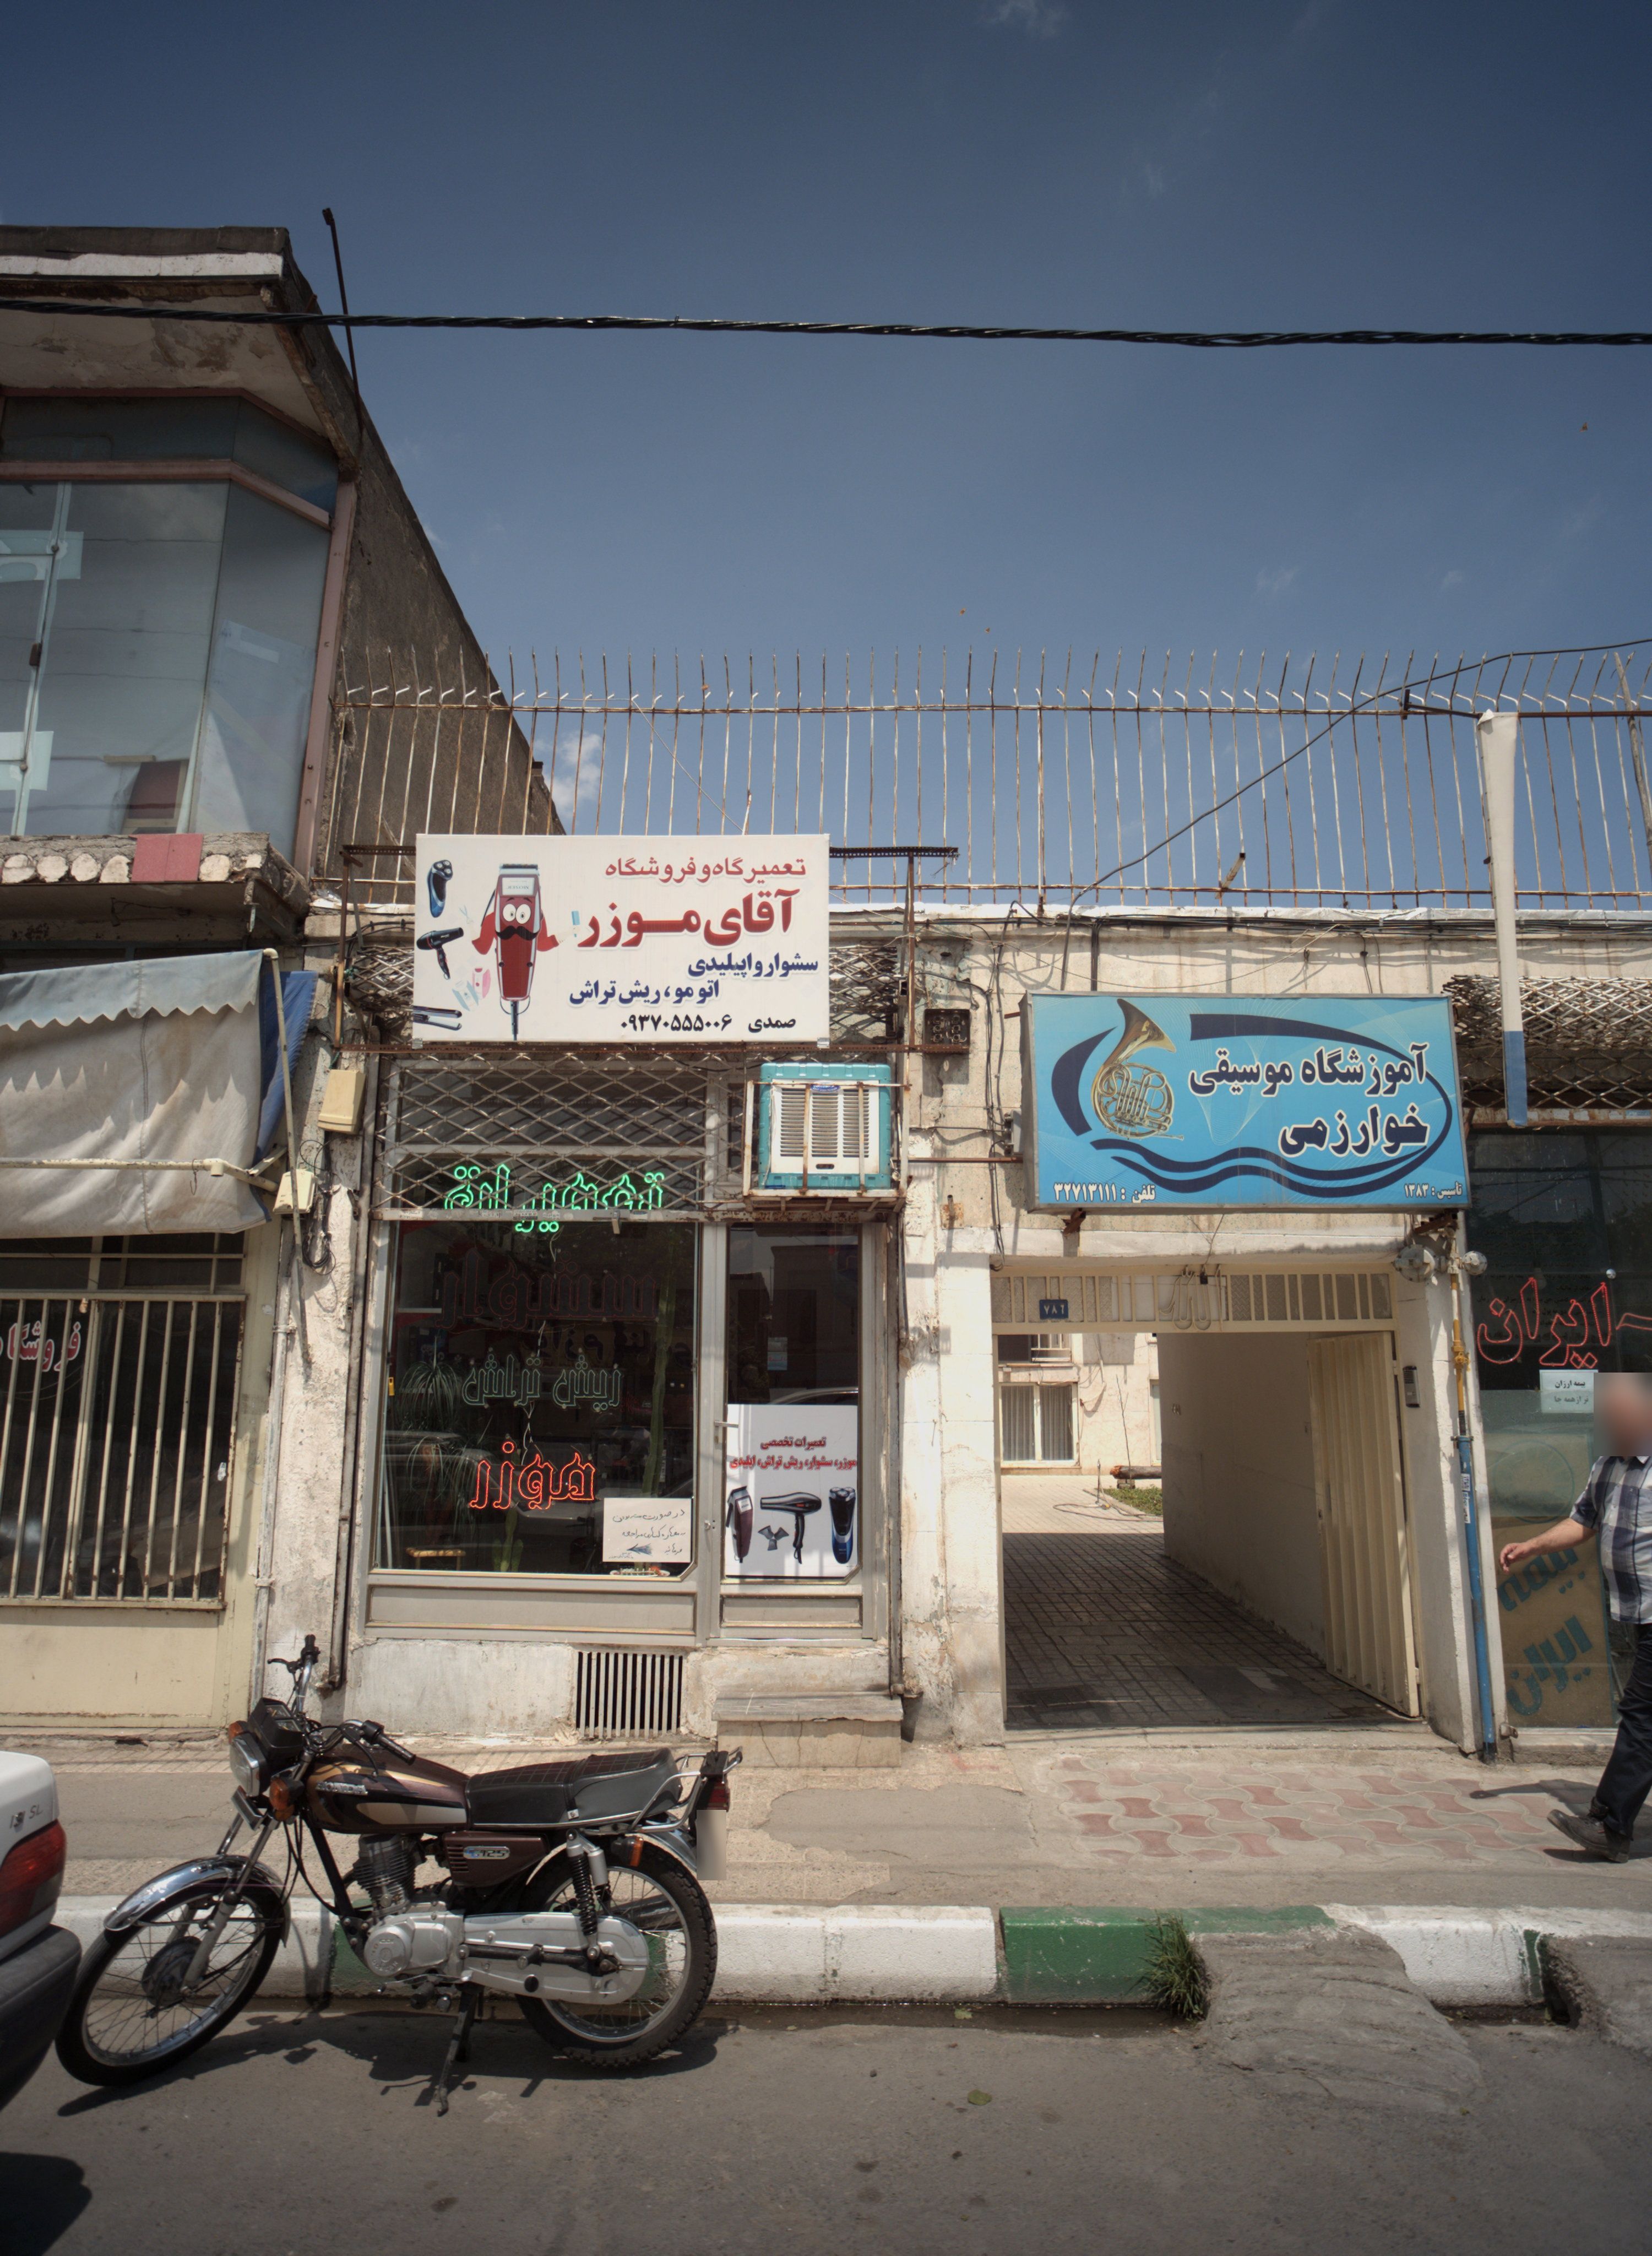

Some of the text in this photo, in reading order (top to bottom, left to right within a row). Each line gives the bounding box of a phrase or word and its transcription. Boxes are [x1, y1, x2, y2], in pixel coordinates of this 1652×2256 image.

[605, 856, 697, 883] فروشگاه
[577, 888, 801, 948] آقای موزر
[764, 952, 819, 978] سشوار
[569, 979, 616, 1005] تراش
[618, 979, 661, 1005] ریش
[620, 1014, 796, 1033] صمدی ۰۹۳۷۰۵۵۵۰۰۶
[1188, 1042, 1430, 1097] آموزشگاه موسیقی
[1279, 1103, 1431, 1157] خوارزمی
[1053, 1183, 1117, 1202] ۳۲۷۱۳۱۱۱
[1404, 1183, 1430, 1198] ۱۳۸۳
[1476, 1277, 1612, 1369] ایران
[0, 1320, 81, 1373] فروشگا
[461, 1353, 623, 1411] ریش تراش
[1555, 1380, 1573, 1389] ارزان
[760, 1436, 827, 1451] تعمیرات تخصصی
[469, 1440, 596, 1510] موزر
[783, 1455, 803, 1470] ریش
[1497, 1547, 1586, 1612] بیمه
[1506, 1615, 1594, 1716] ایران
